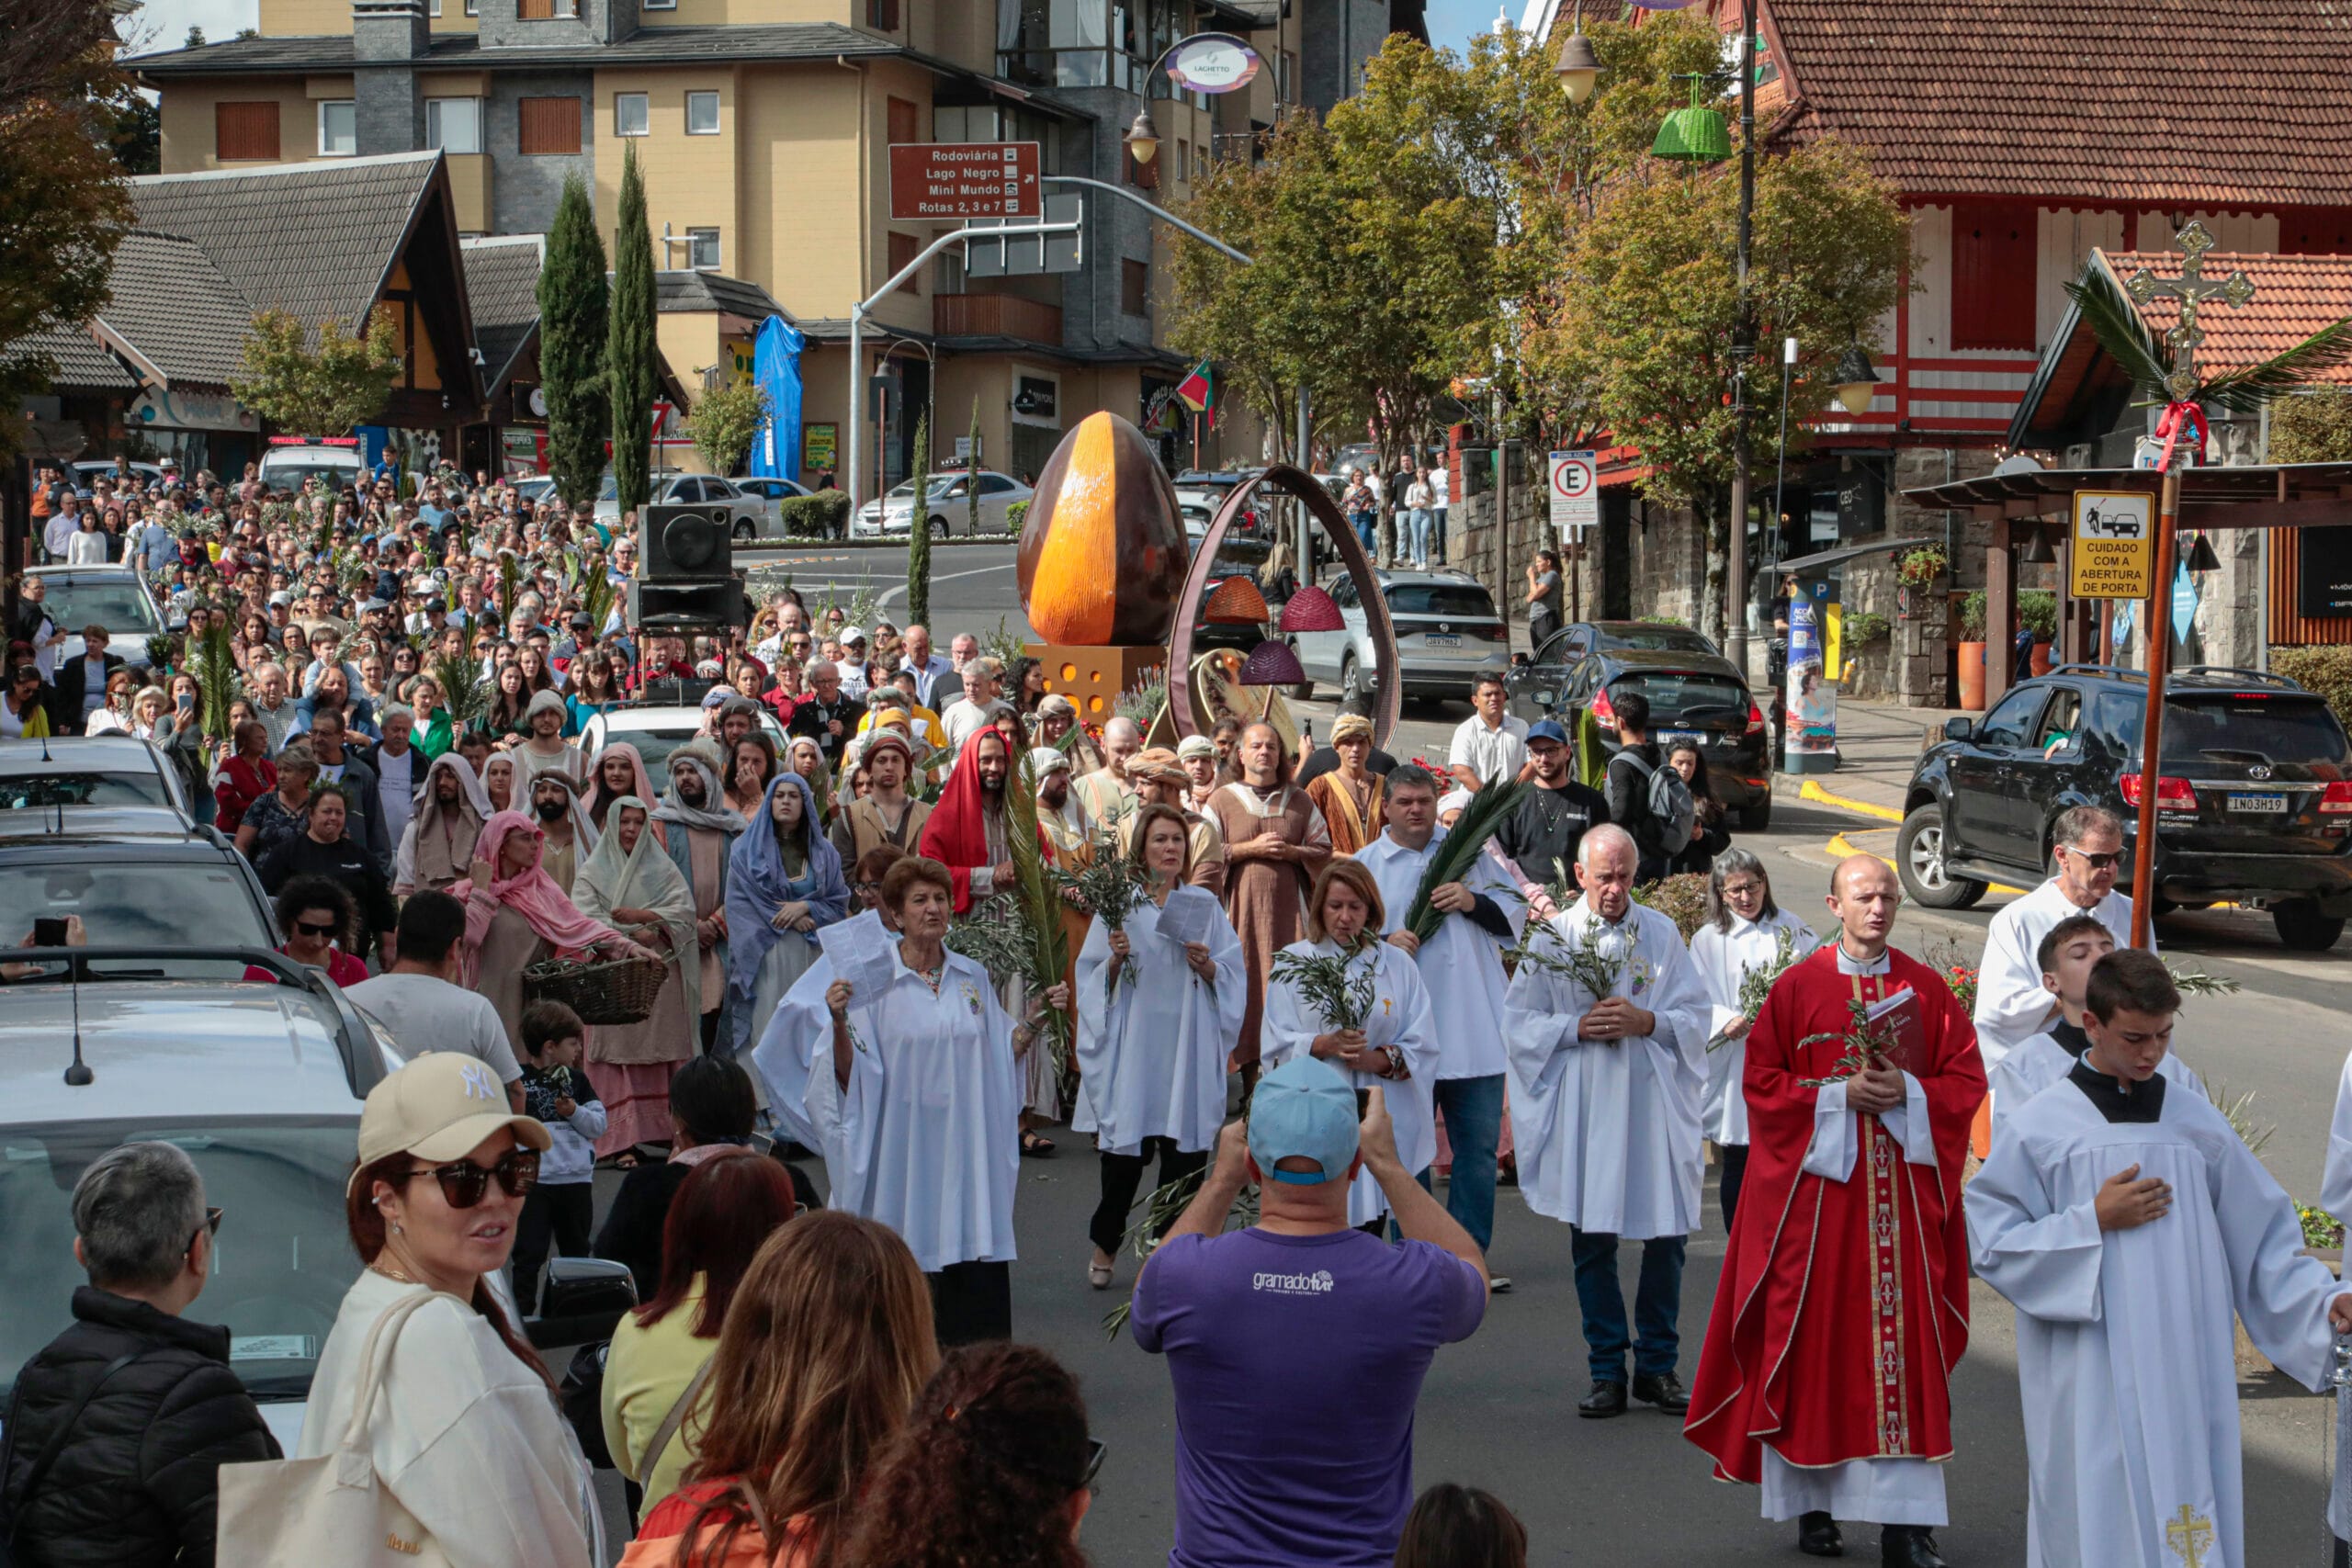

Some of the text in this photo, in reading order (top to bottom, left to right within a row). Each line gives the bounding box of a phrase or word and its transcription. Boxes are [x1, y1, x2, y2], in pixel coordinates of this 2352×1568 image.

[933, 150, 998, 162] Rodoviária
[926, 167, 1000, 180] Lago Negro
[929, 184, 1001, 196] Mini Mundo
[919, 202, 954, 213] Rotas
[958, 201, 969, 213] 2,
[972, 201, 979, 211] 3
[994, 201, 1001, 211] 7
[1566, 468, 1579, 489] E
[2086, 542, 2138, 553] CUIDADO
[2094, 556, 2130, 566] COM A
[2080, 570, 2142, 580] ABERTURA
[1816, 583, 1826, 597] P
[2083, 582, 2139, 592] DE PORTA
[460, 1064, 496, 1100] NY
[1253, 1271, 1334, 1292] gramadotur
